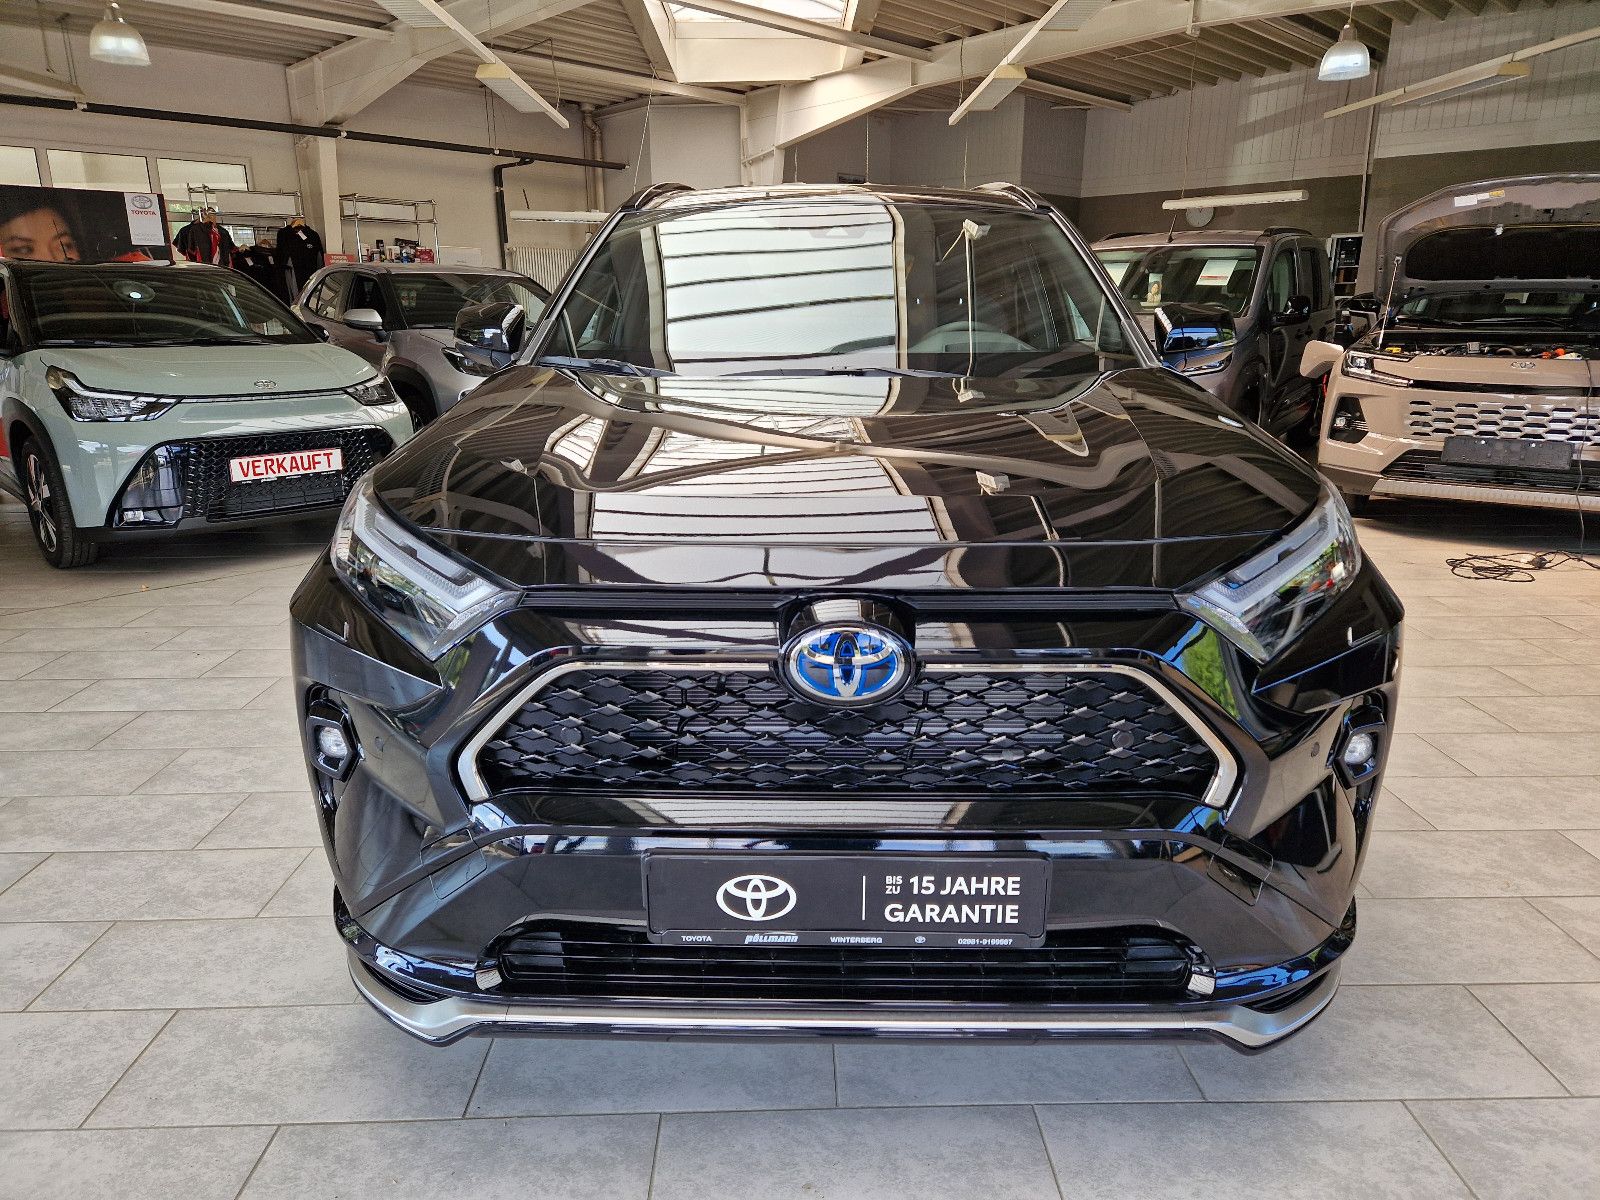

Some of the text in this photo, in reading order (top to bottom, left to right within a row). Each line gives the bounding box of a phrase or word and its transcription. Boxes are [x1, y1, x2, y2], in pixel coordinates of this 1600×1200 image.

[239, 453, 333, 477] VERKAUFT
[885, 875, 903, 885] BIS
[909, 875, 1021, 896] 15 JAHRE
[885, 885, 901, 895] ZU
[884, 903, 1020, 924] GARANTIE
[830, 936, 883, 944] WINTERBERG
